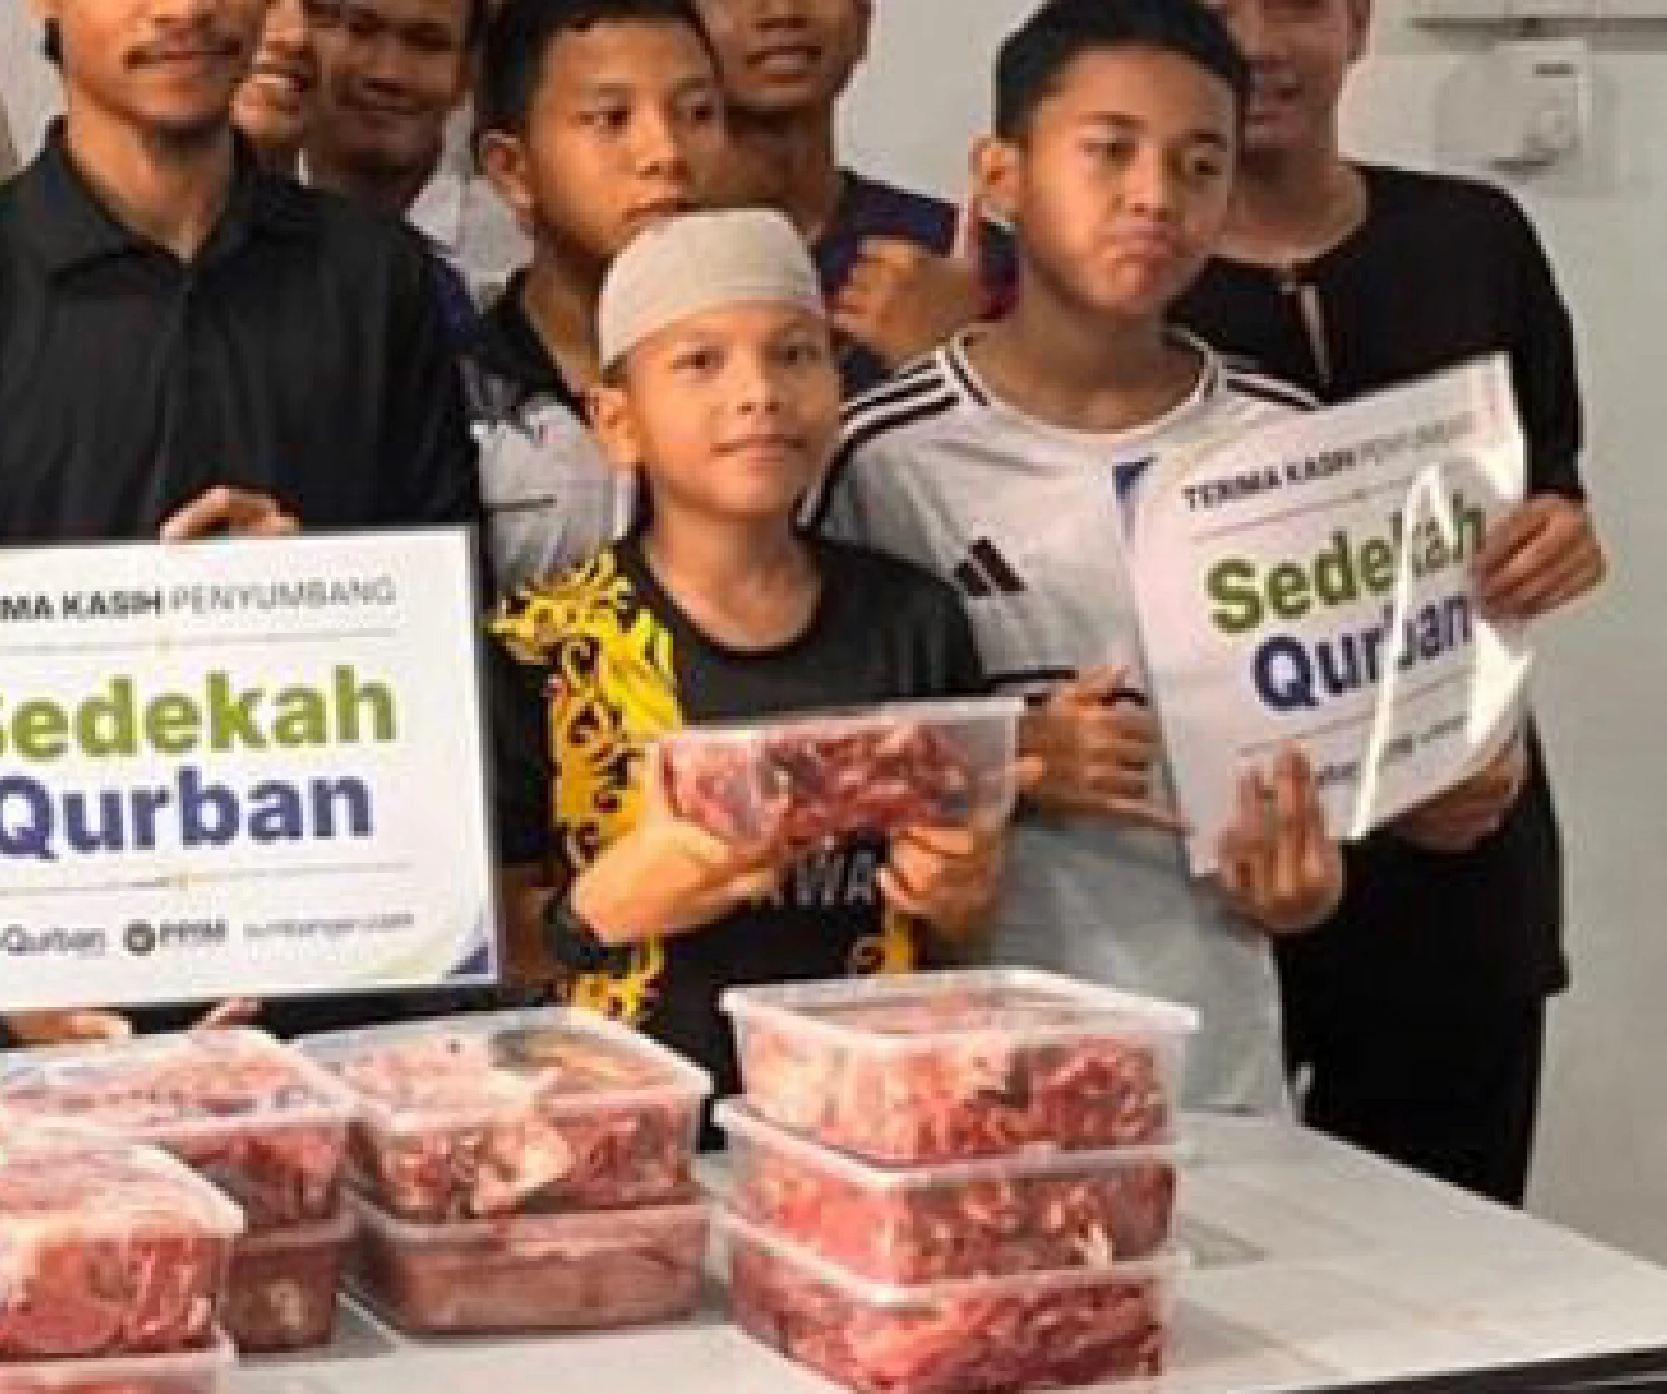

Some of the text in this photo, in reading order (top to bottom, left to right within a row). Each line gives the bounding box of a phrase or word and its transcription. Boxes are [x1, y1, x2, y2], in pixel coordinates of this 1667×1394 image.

[1181, 465, 1283, 512] TERIMA
[1285, 445, 1357, 486] KASIH
[62, 588, 163, 619] KASIH
[168, 575, 397, 614] PENYUMBANG
